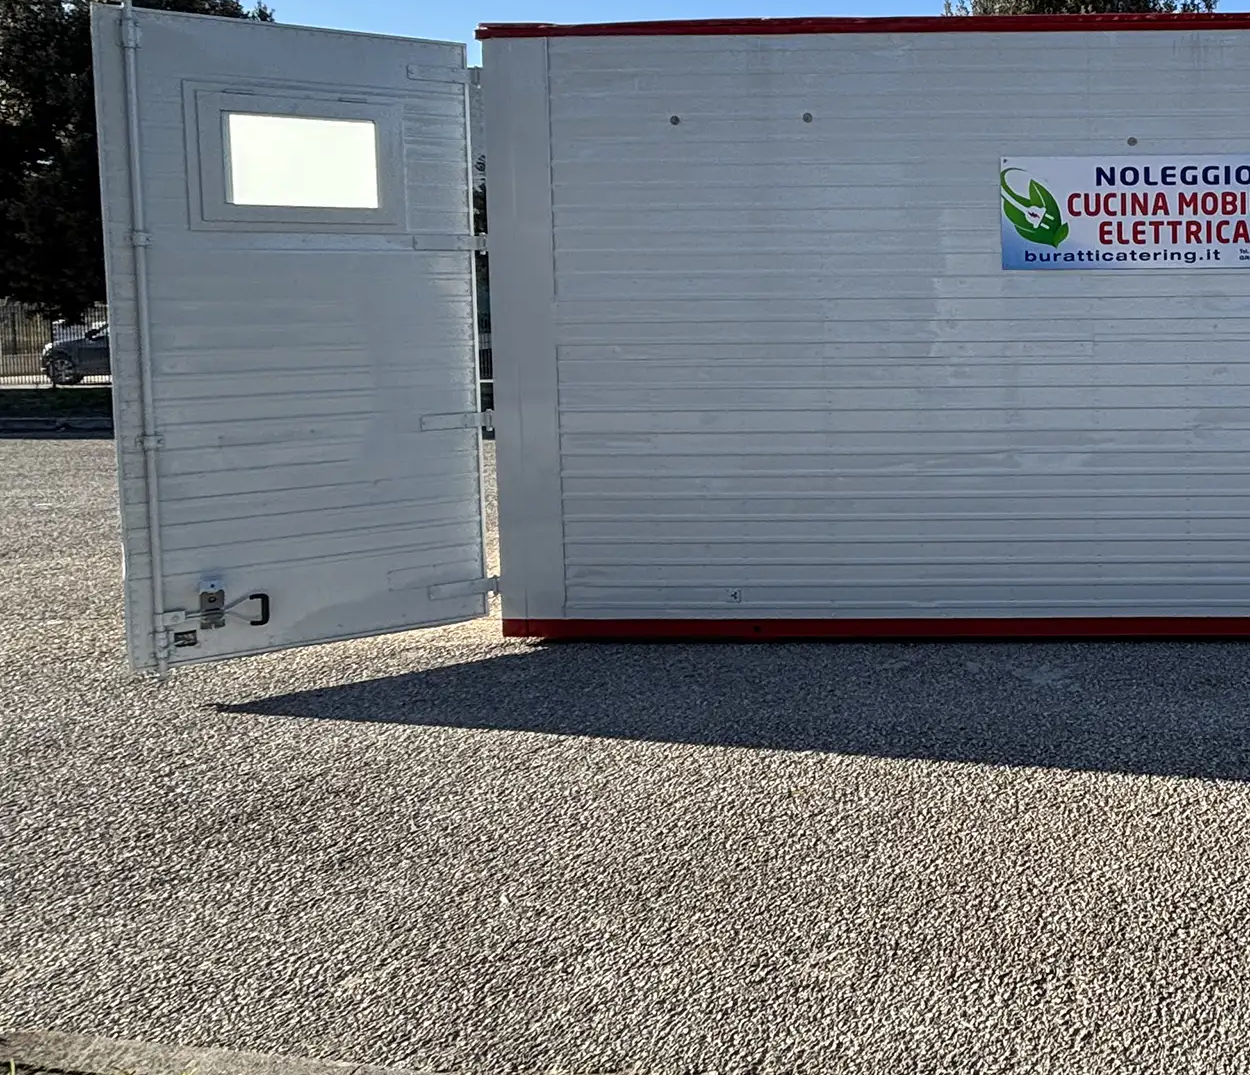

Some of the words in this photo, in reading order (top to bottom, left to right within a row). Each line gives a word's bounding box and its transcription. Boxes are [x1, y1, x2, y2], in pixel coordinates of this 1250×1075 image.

[1067, 192, 1174, 217] CUCINA
[1099, 220, 1250, 245] ELETTRICA
[1024, 249, 1221, 263] buratticatering.it
